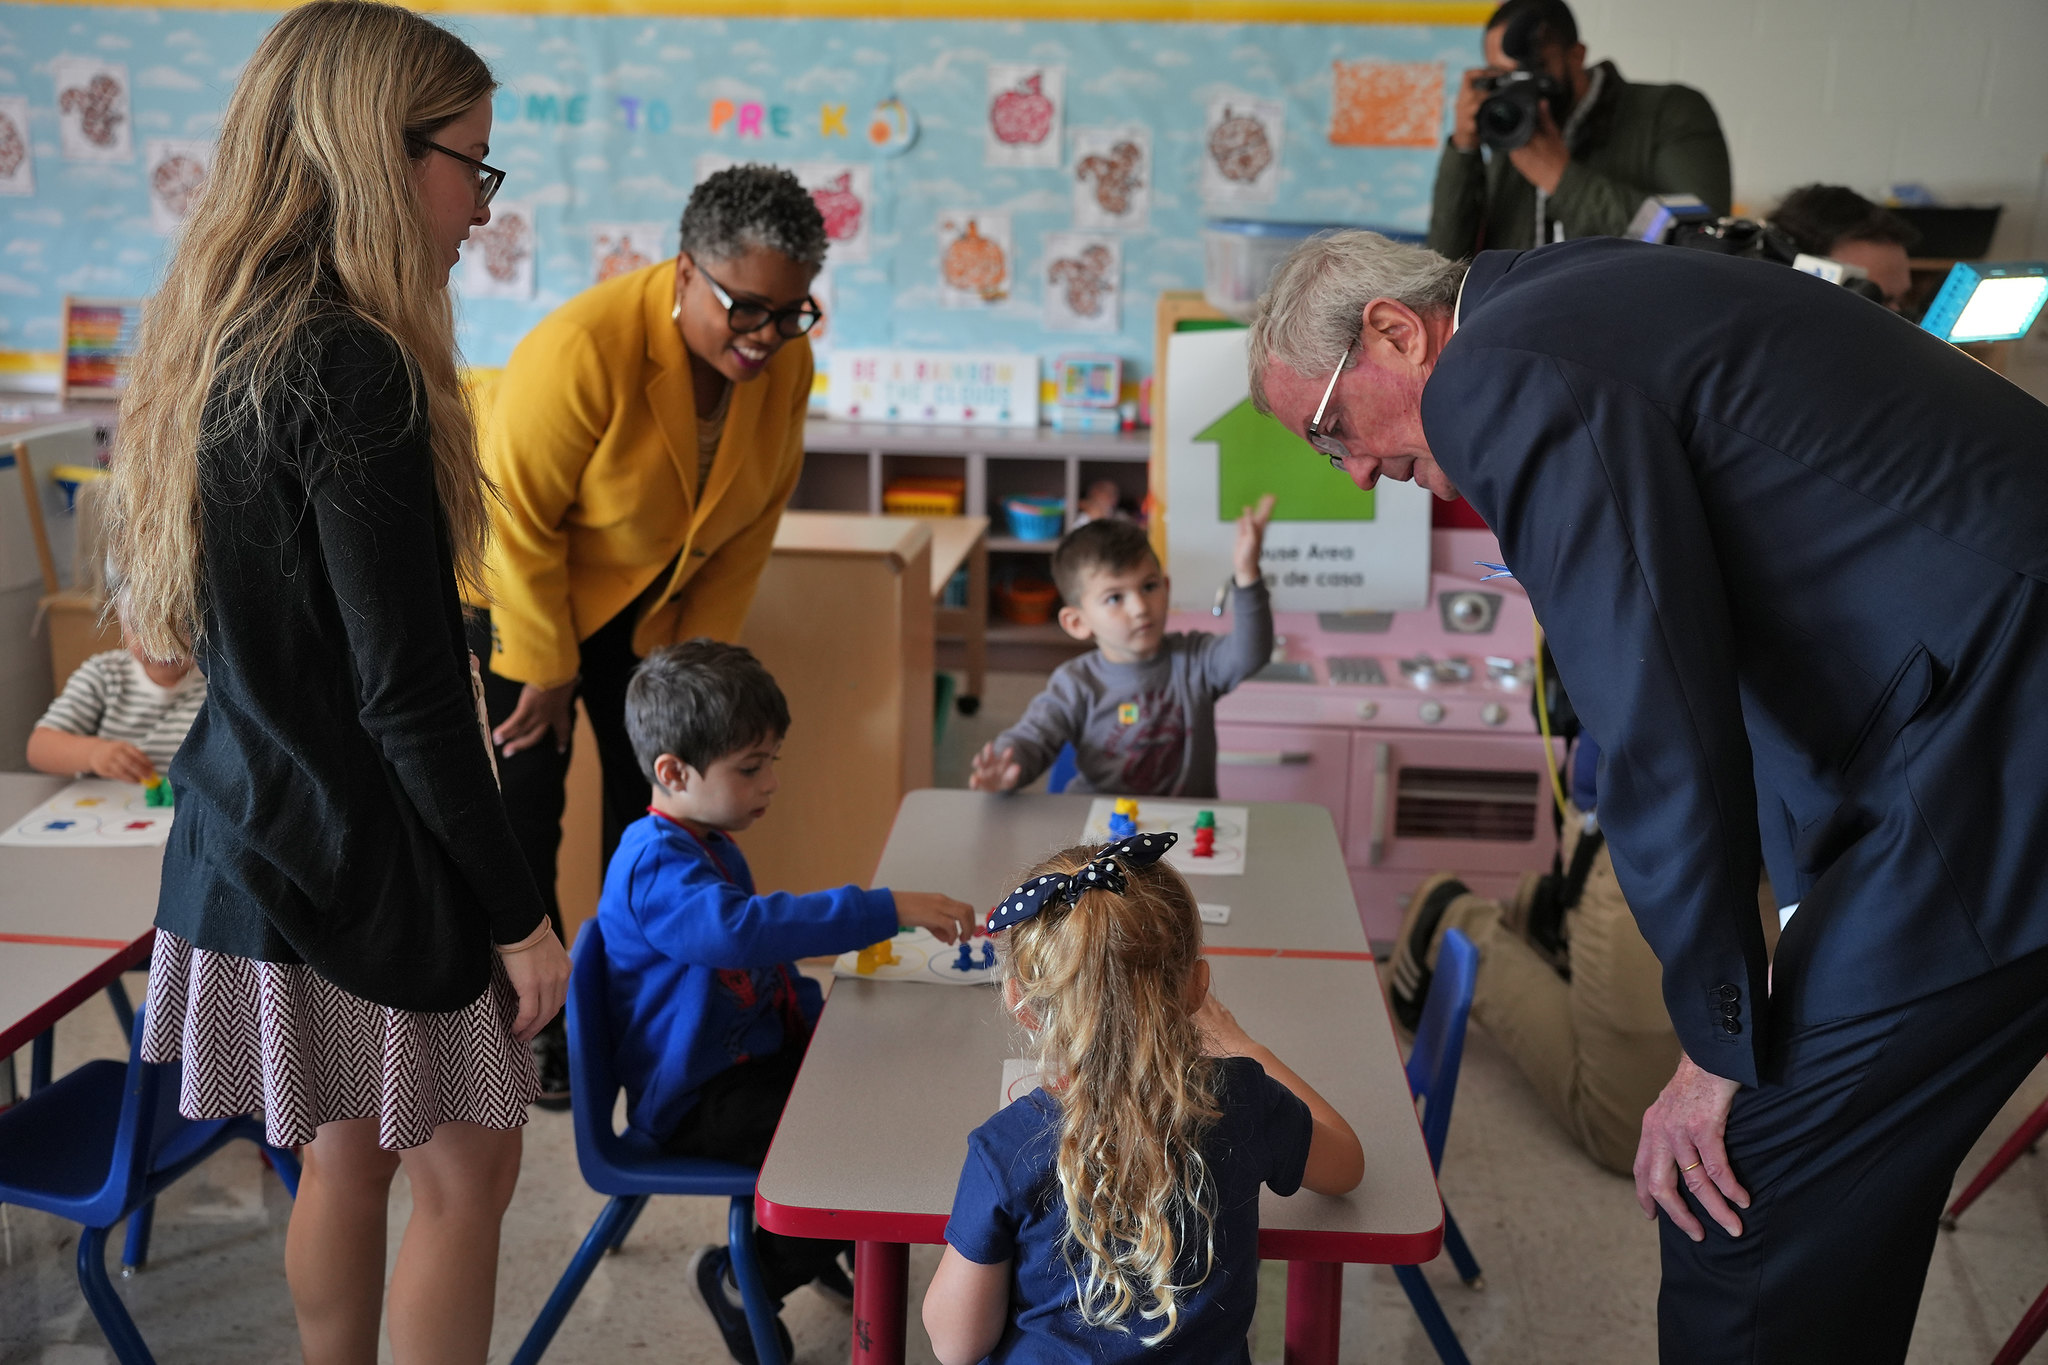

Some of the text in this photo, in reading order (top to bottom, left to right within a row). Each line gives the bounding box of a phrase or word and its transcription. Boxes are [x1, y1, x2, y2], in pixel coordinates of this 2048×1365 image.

[494, 90, 847, 139] OME TO PRE K
[853, 358, 877, 381] BE
[1260, 544, 1354, 561] ouse Area
[1282, 569, 1309, 587] de
[1316, 571, 1364, 587] casa
